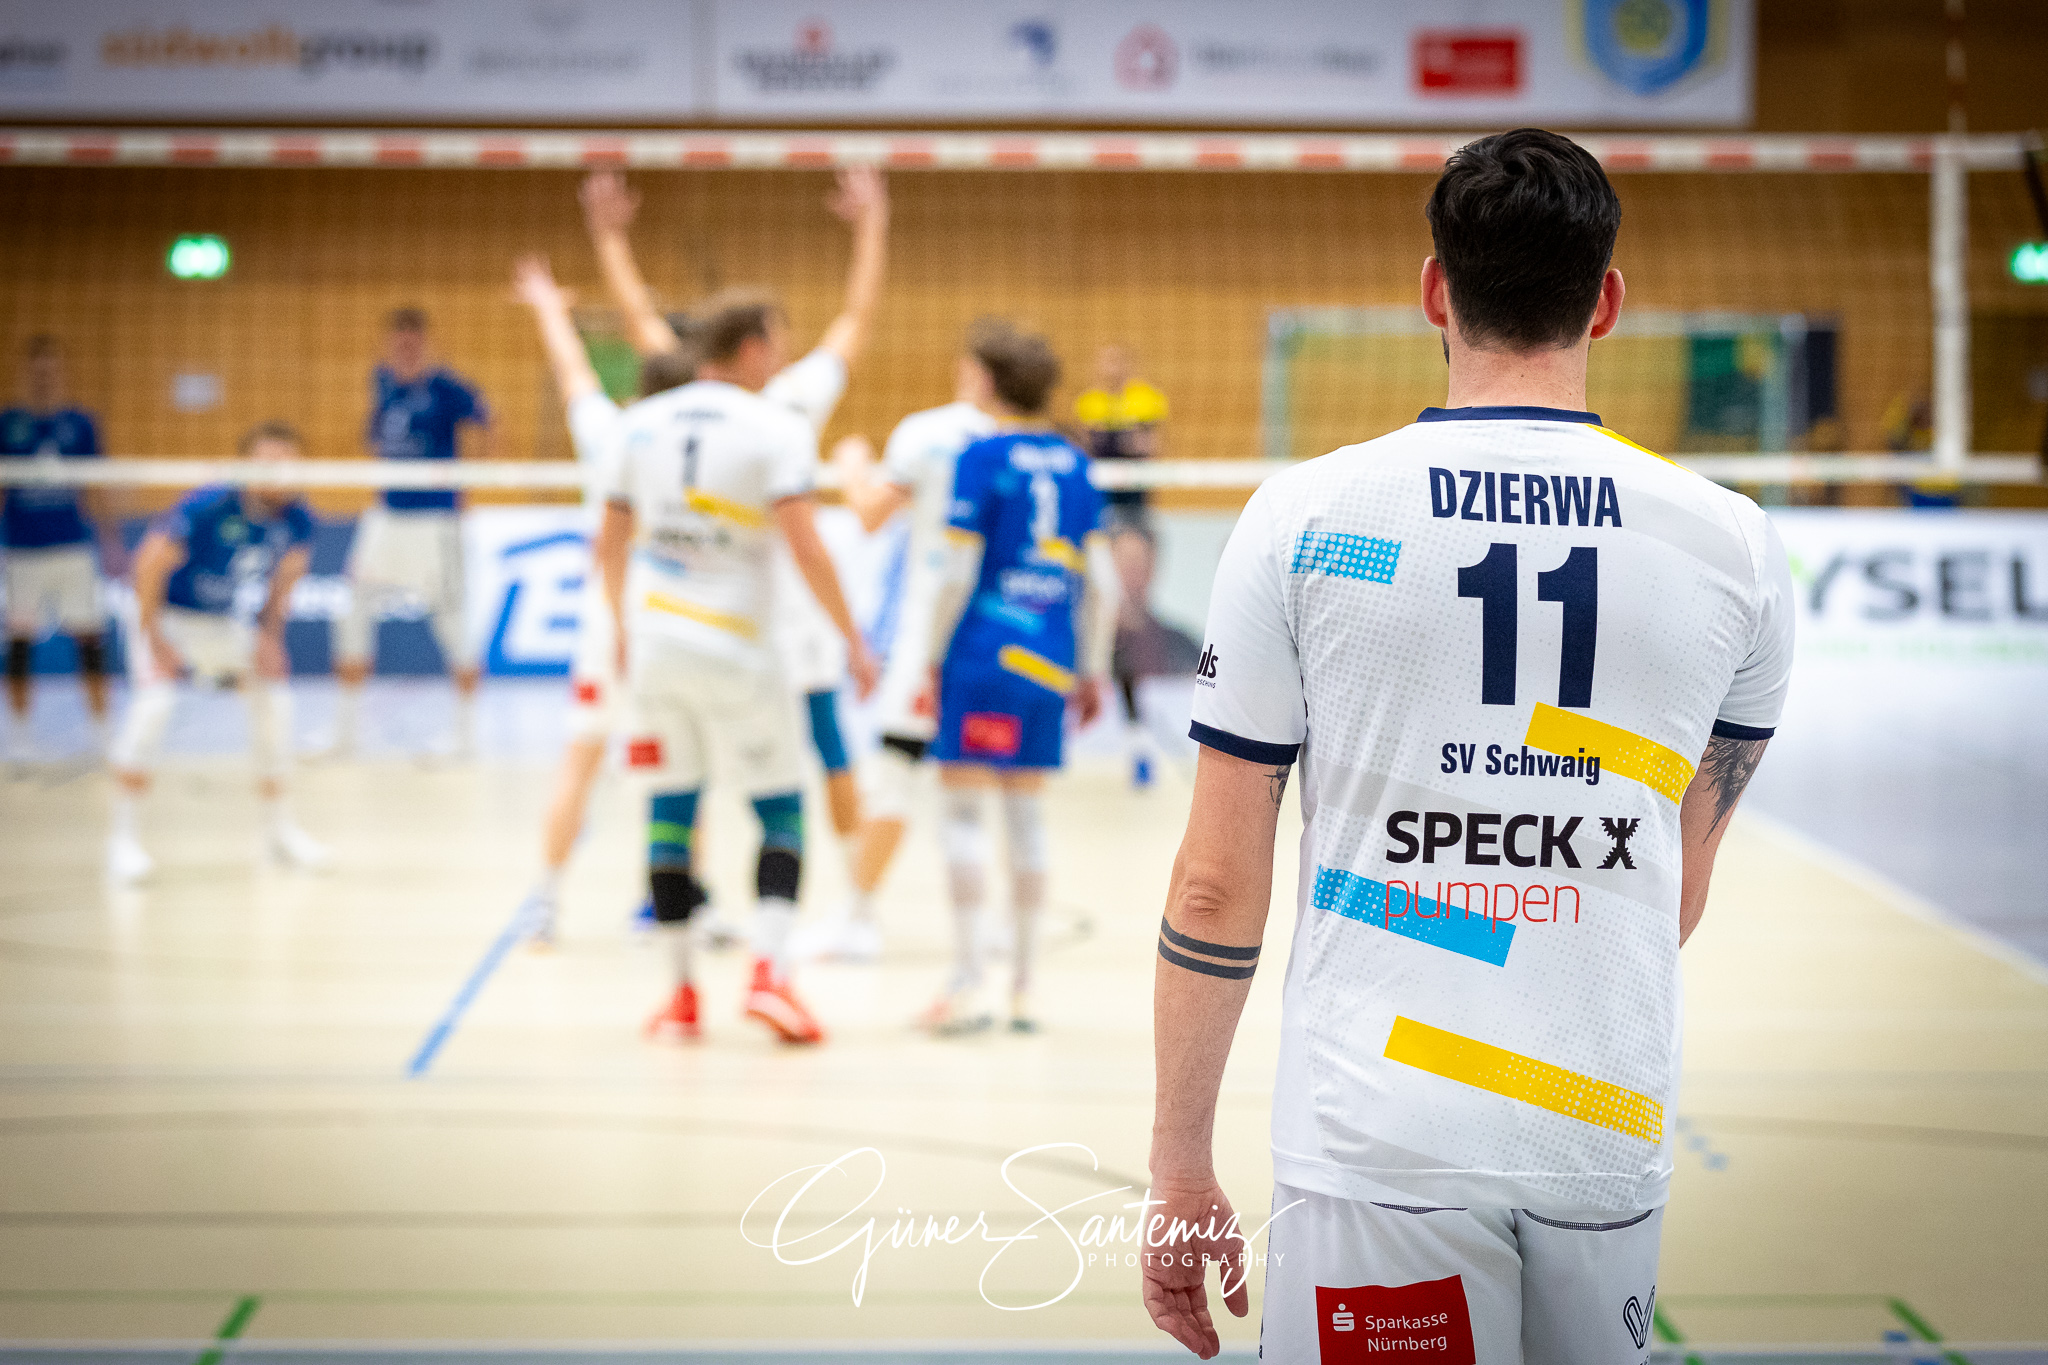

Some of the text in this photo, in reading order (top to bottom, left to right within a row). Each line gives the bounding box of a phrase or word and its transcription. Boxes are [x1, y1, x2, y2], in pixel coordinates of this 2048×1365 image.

[1428, 467, 1623, 528] DZIERWA
[1457, 542, 1598, 709] 11
[1440, 742, 1601, 786] SV Schwaig
[1385, 810, 1584, 869] SPECK
[1384, 878, 1581, 934] pumpen
[1365, 1310, 1449, 1333] Sparkasse
[1367, 1335, 1448, 1353] Nürnberg
